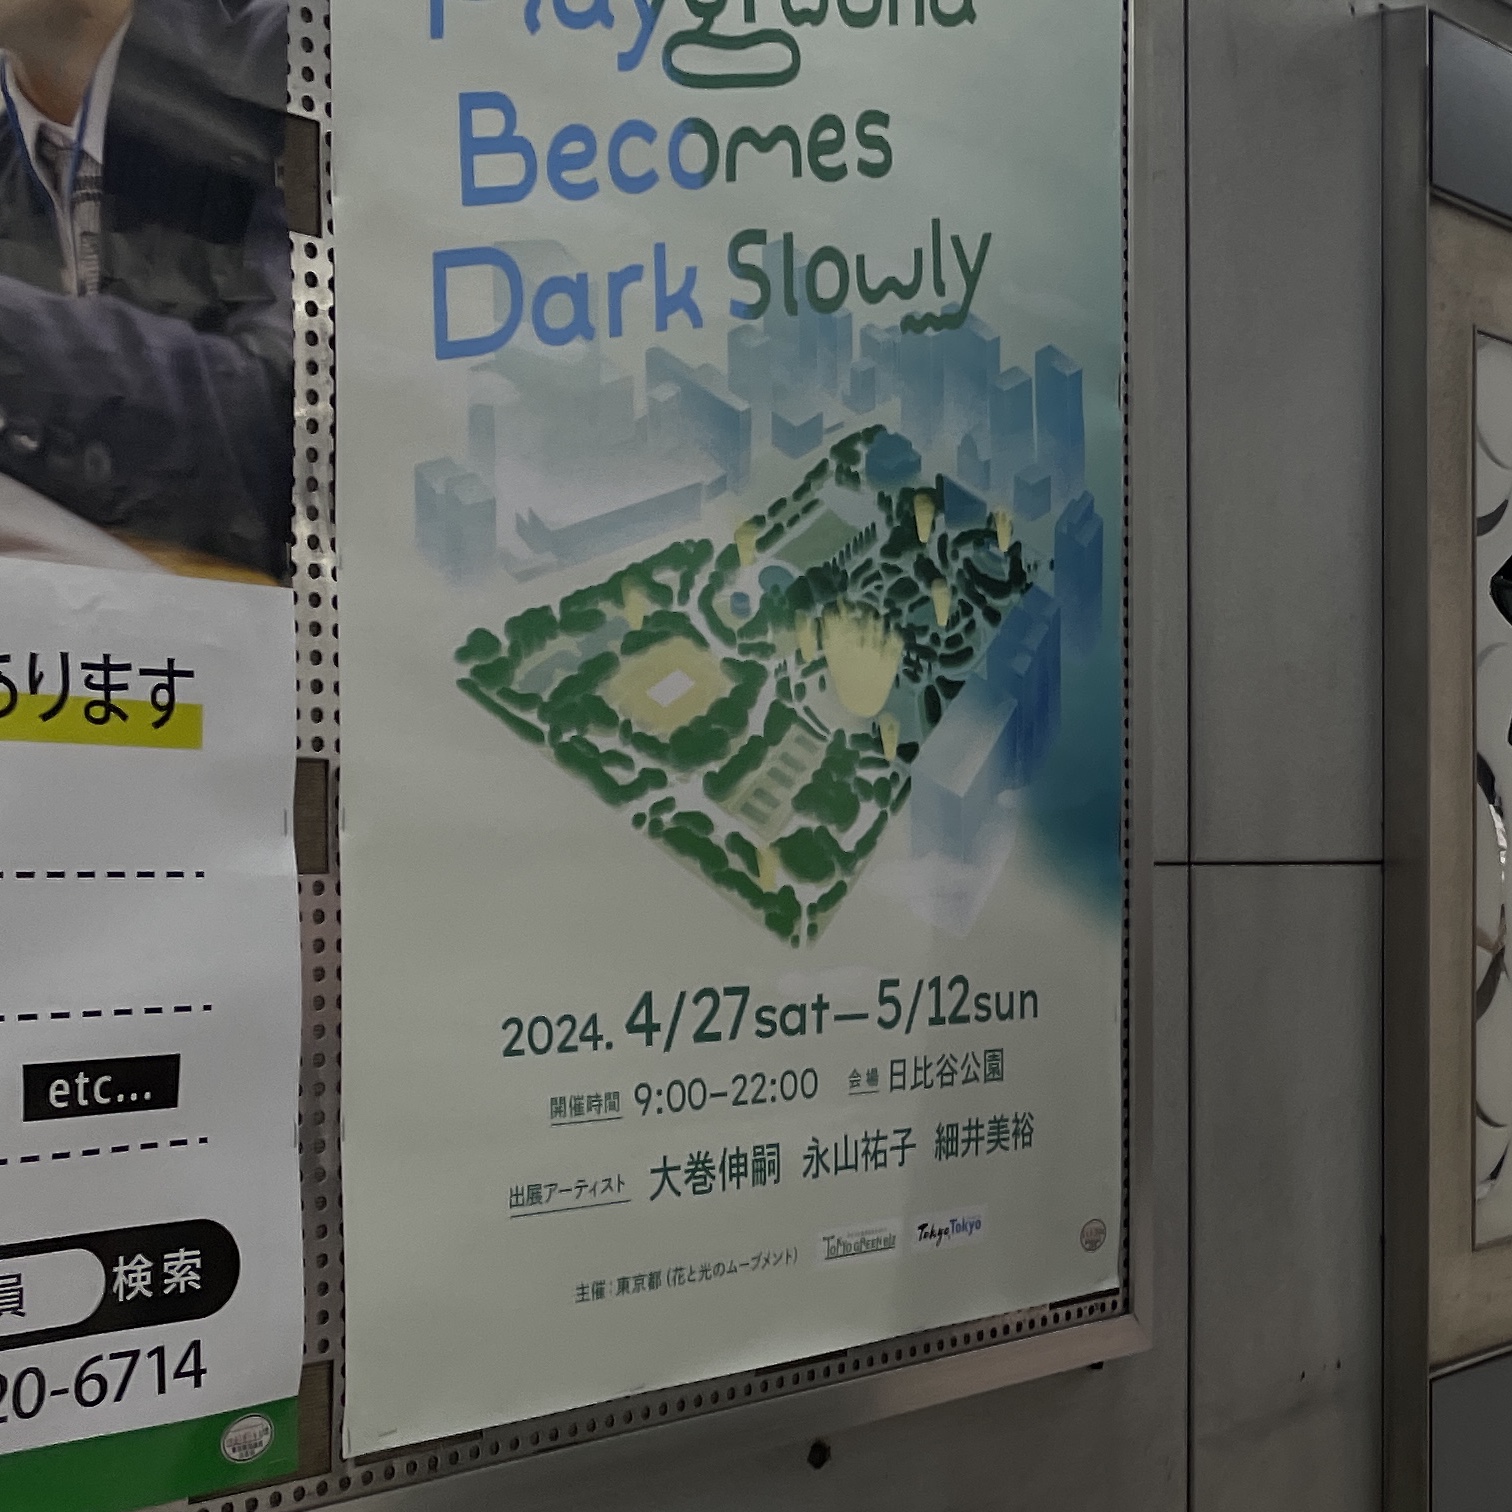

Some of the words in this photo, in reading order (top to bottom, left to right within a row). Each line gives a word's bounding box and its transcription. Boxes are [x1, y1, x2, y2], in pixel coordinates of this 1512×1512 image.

[458, 91, 894, 207] Becomes
[432, 242, 704, 360] Dark
[727, 217, 992, 335] Slowly
[501, 1012, 613, 1058] 2024.
[48, 1071, 152, 1108] etc...
[550, 1090, 621, 1119] 開催時間
[848, 1067, 879, 1089] 会場
[889, 1048, 1004, 1093] 日比谷公園
[509, 1173, 626, 1209] 出展アーティスト
[649, 1142, 780, 1201] 大巻伸嗣
[802, 1127, 917, 1179] 永山祐子
[934, 1111, 1035, 1162] 細井美裕
[112, 1247, 202, 1302] 検索
[0, 1338, 208, 1424] 0-6714
